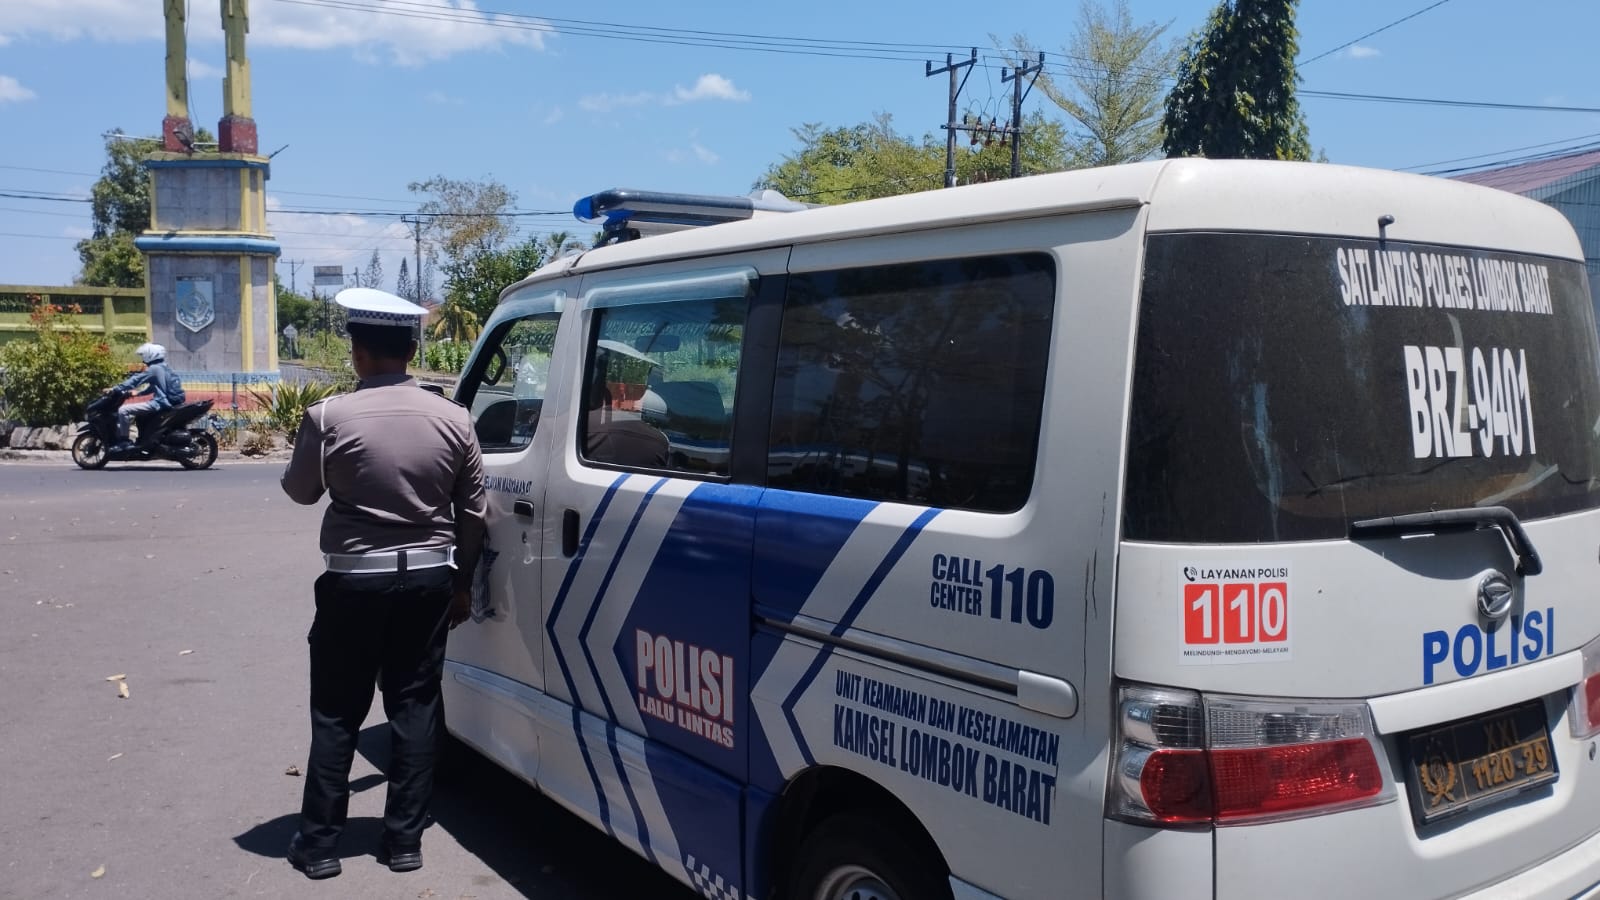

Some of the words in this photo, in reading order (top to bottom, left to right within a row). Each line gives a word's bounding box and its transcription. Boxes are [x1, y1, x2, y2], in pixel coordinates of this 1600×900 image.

[1337, 247, 1423, 307] SATLANTAS
[1420, 253, 1473, 309] POLRES
[1470, 257, 1522, 312] LOMBOK
[1517, 262, 1553, 314] BARAT
[1404, 345, 1536, 458] BRZ-9401
[930, 581, 982, 616] CENTER
[932, 553, 983, 587] CALL
[985, 563, 1054, 629] 110
[1201, 568, 1256, 579] LAYANAN
[1257, 567, 1288, 579] POLISI
[1192, 588, 1285, 638] 110
[1423, 607, 1554, 685] POLISI
[636, 629, 734, 723] POLISI
[639, 692, 675, 724] LALU
[677, 706, 735, 749] LINTAS
[835, 669, 862, 700] UNIT
[862, 677, 927, 724] KEAMANAN
[928, 697, 956, 733] DAN
[957, 706, 1059, 766] KESELAMATAN
[833, 704, 896, 768] KAMSEL
[900, 726, 980, 799] LOMBOK
[983, 753, 1056, 827] BARAT
